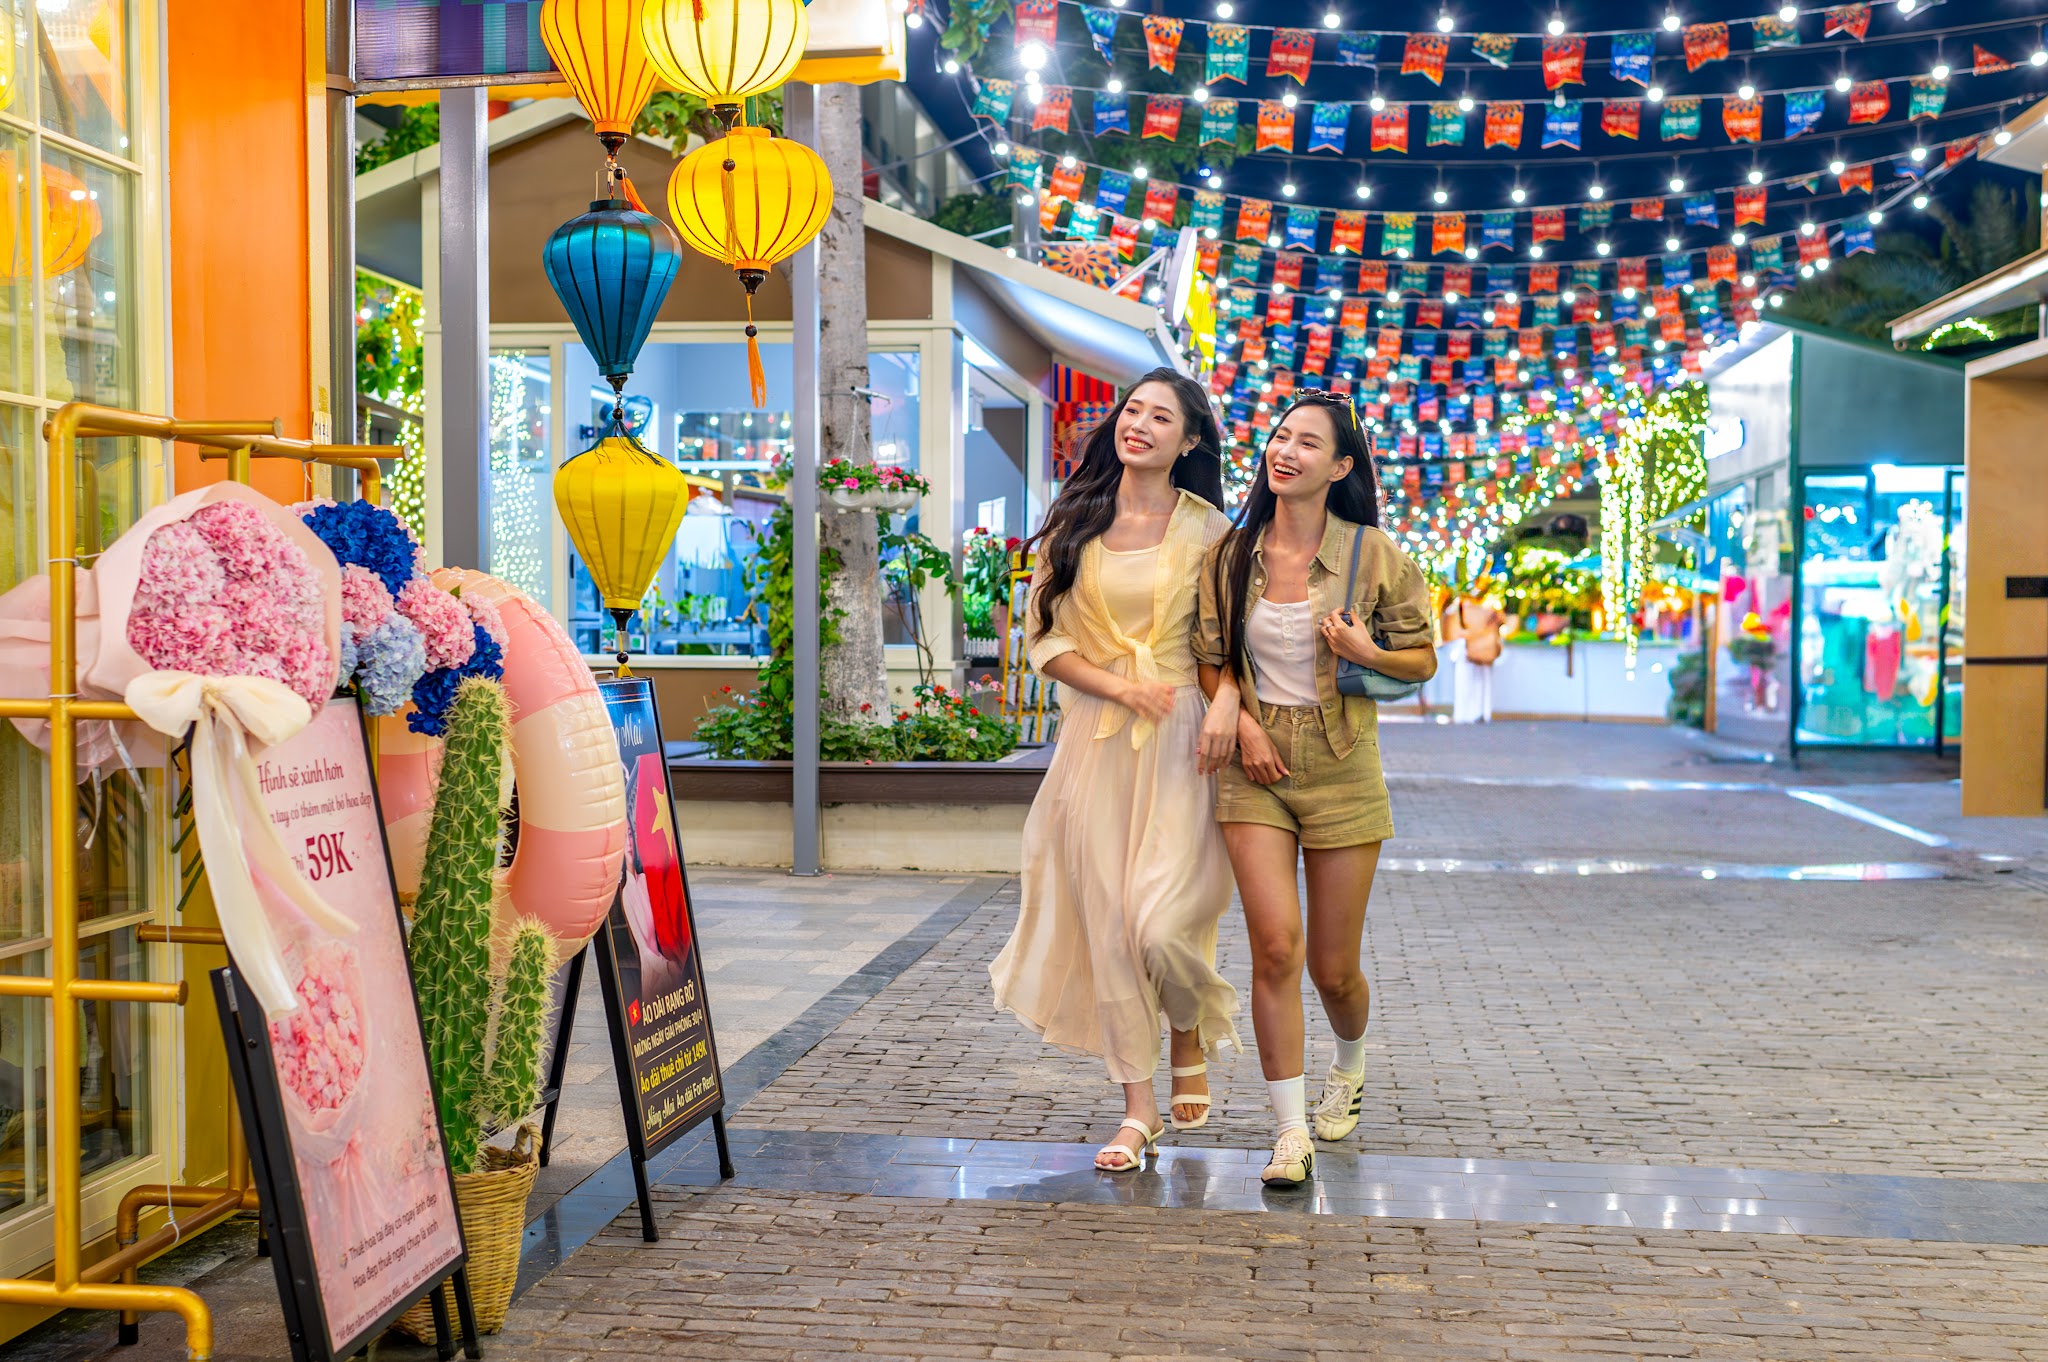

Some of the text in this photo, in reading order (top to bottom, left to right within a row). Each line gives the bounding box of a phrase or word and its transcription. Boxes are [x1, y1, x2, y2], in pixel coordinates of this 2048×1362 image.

[621, 713, 643, 747] Mai
[289, 767, 299, 788] sẽ
[301, 759, 324, 786] xinh
[323, 758, 344, 781] hơn
[276, 809, 290, 828] tay
[290, 803, 300, 821] có
[300, 801, 321, 818] thêm
[321, 798, 336, 816] một
[335, 794, 345, 811] bó
[345, 793, 360, 809] hoa
[360, 792, 372, 809] đẹp
[306, 831, 353, 881] 59K
[642, 978, 695, 1027] ÁO DÀI RẠNG RỠ
[633, 1008, 703, 1058] MỪNG NGÀY GIẢI PHÓNG 30/4
[639, 1039, 708, 1095] Áo dài thuê chỉ từ 149K
[662, 1097, 675, 1119] Mai
[676, 1089, 685, 1109] Áo
[684, 1086, 693, 1104] dài
[692, 1082, 702, 1098] For
[702, 1073, 715, 1092] Rent
[348, 1241, 365, 1260] Thuê
[364, 1236, 377, 1250] hoa
[402, 1209, 416, 1225] ngay
[426, 1194, 438, 1208] đẹp
[352, 1274, 367, 1290] Hoa
[366, 1266, 379, 1280] đẹp
[392, 1244, 407, 1262] ngay
[420, 1226, 427, 1240] là
[426, 1219, 440, 1236] xinh
